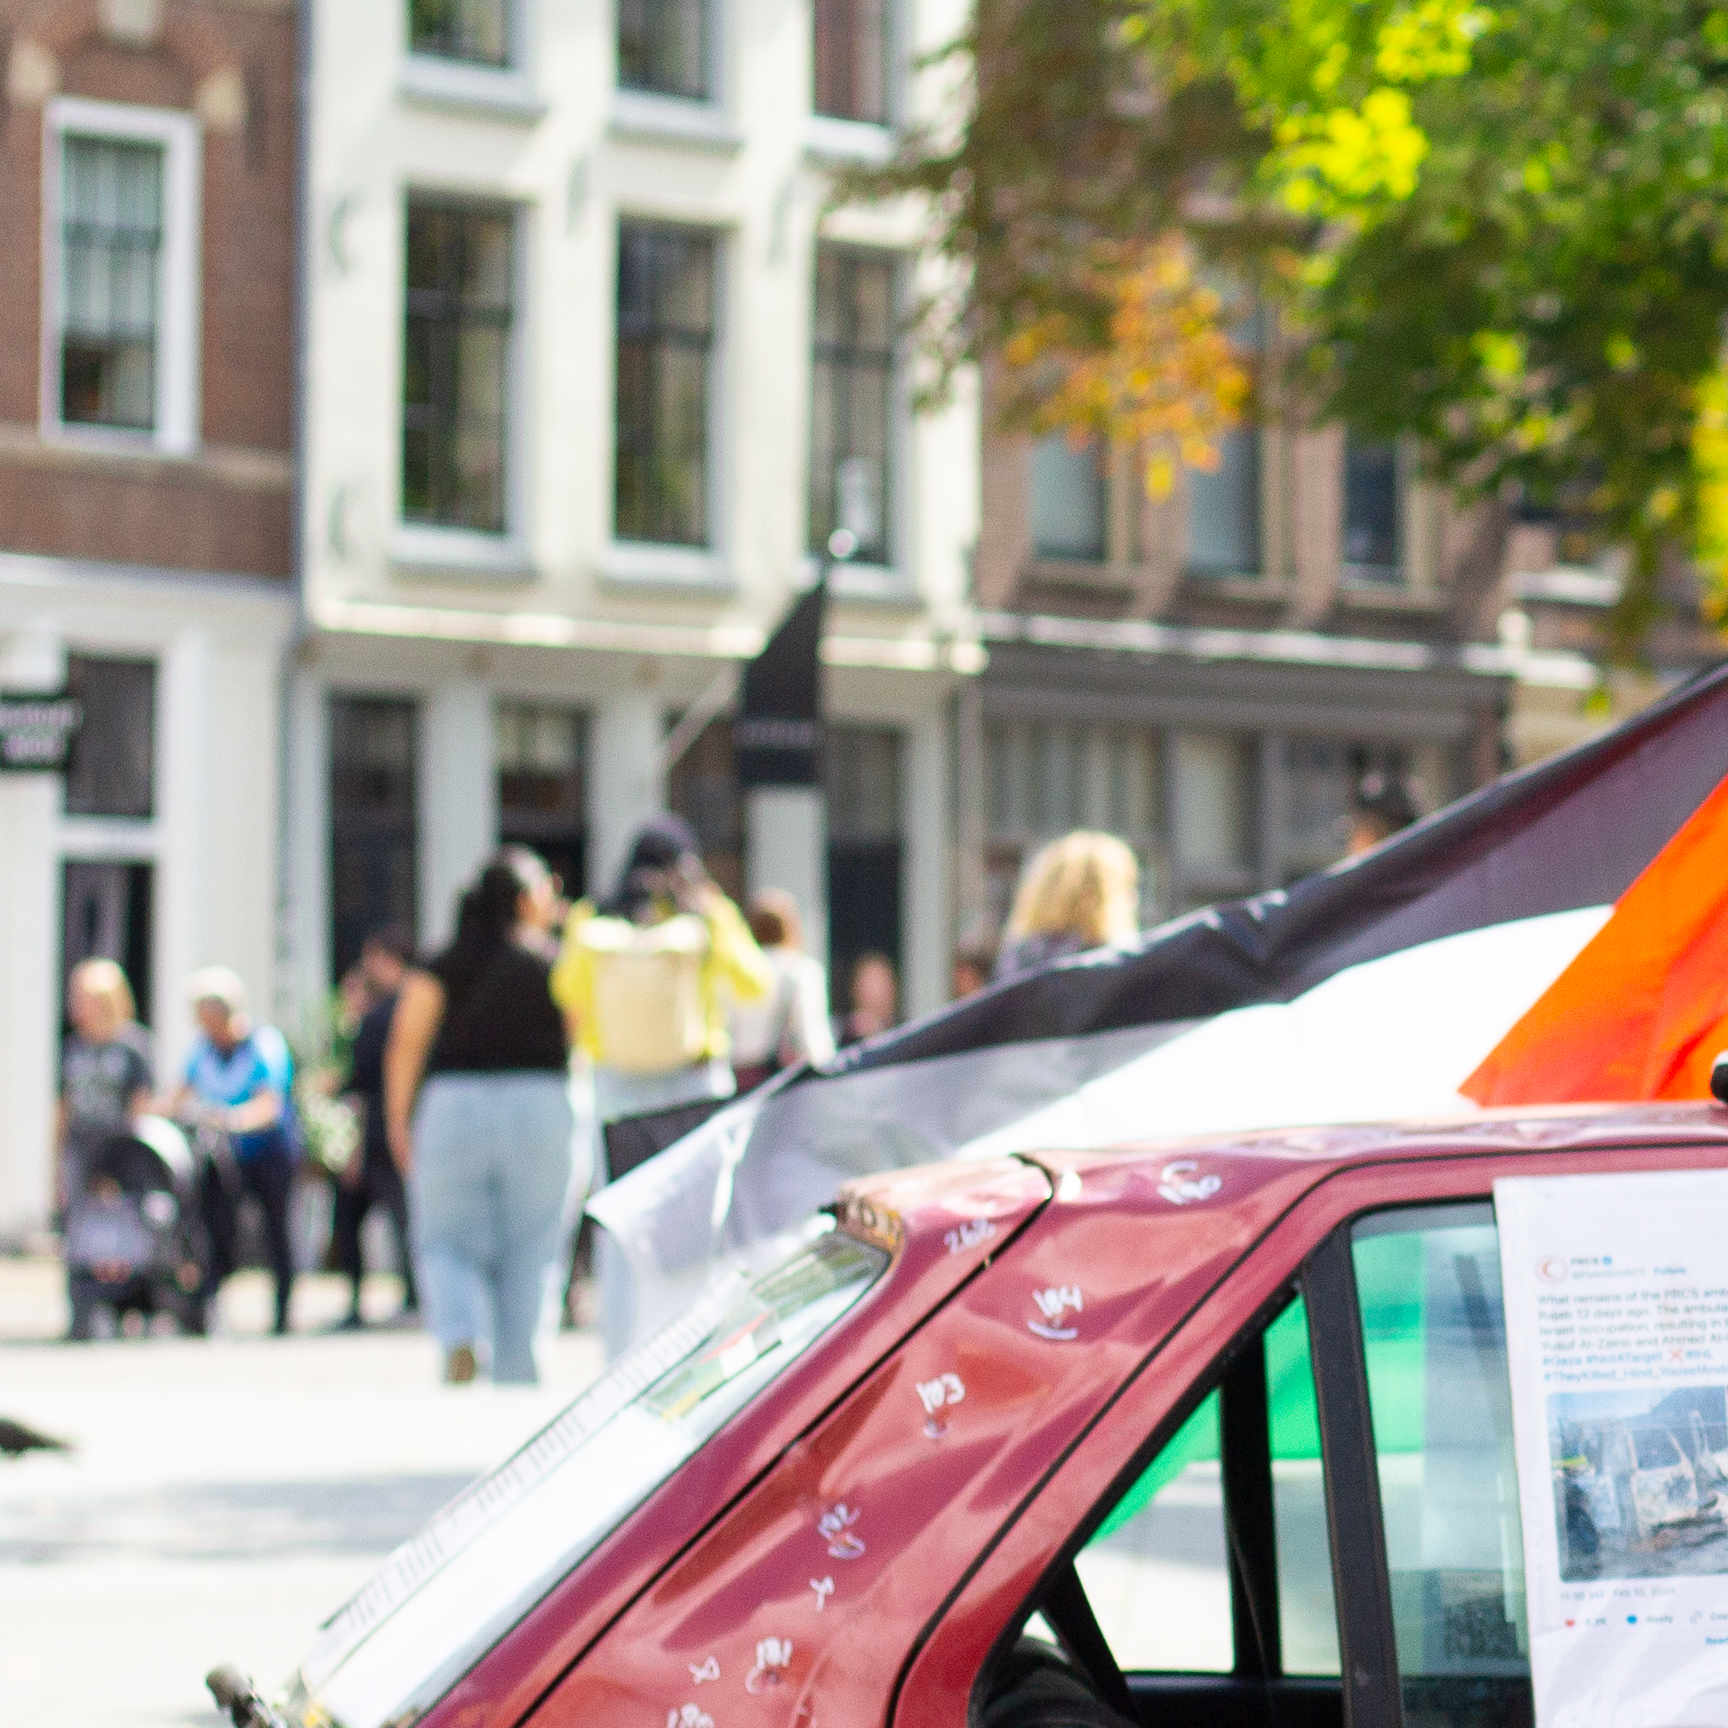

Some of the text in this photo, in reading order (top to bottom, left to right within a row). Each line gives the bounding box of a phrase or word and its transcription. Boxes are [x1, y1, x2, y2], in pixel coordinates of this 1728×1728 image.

[1537, 1294, 1569, 1305] What
[1573, 1293, 1622, 1303] remains
[1625, 1291, 1637, 1301] of
[1641, 1291, 1660, 1300] the
[1665, 1288, 1699, 1298] PRCS
[1577, 1309, 1590, 1320] 12
[1593, 1309, 1622, 1320] days
[1657, 1305, 1679, 1314] The
[1654, 1319, 1707, 1331] resulting
[1711, 1318, 1721, 1328] in
[1636, 1336, 1659, 1347] and
[1662, 1334, 1706, 1345] Ahmed
